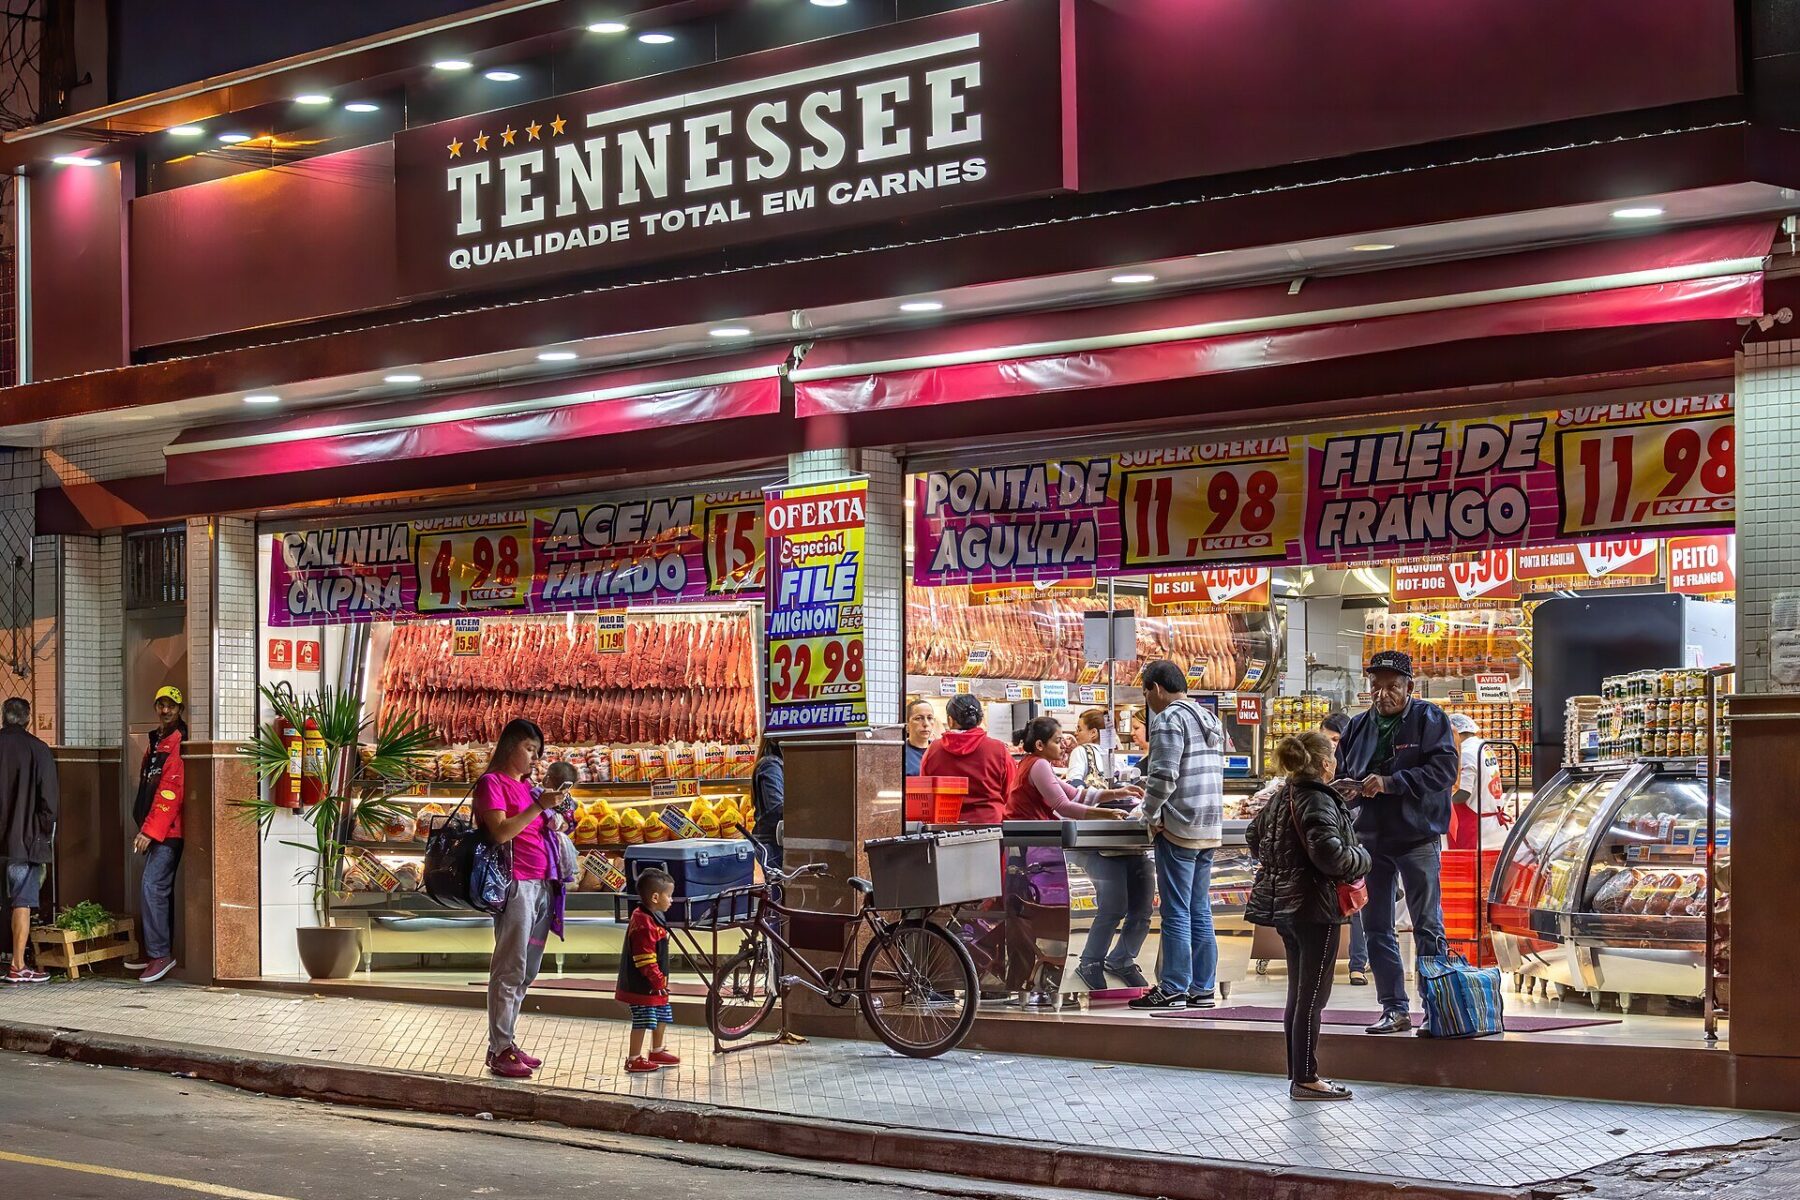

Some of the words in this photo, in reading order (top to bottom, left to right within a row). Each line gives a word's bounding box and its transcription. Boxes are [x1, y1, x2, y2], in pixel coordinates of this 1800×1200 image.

[447, 61, 982, 236] TENNESSEE
[449, 218, 631, 270] QUALIDADE
[640, 197, 751, 236] TOTAL
[762, 184, 816, 216] EM
[828, 156, 988, 207] CARNES
[1557, 401, 1645, 426] SUPER
[1119, 444, 1192, 468] SUPER
[1200, 436, 1290, 458] OFERTA
[1320, 422, 1444, 487] FILÉ
[1459, 418, 1542, 475] DE
[925, 464, 1048, 515] PONTA
[1057, 459, 1110, 507] DE
[1580, 425, 1735, 526] 11,98
[768, 497, 865, 531] OFERTA
[1135, 470, 1279, 558] 11,98
[1317, 484, 1531, 549] FRANGO
[1656, 497, 1735, 515] KILO
[543, 499, 695, 550] ACEM
[282, 523, 411, 569] GALINHA
[780, 532, 844, 564] Especial
[929, 520, 1097, 573] AGULHA
[1203, 533, 1270, 551] KILO
[1672, 545, 1719, 571] PEITO
[431, 535, 519, 605] 4,98
[1519, 553, 1541, 568] PONTA
[1541, 553, 1549, 567] DE
[1549, 552, 1575, 567] AGULHA
[541, 554, 687, 600] FATIADO
[779, 553, 857, 606] FILÉ
[1154, 582, 1170, 595] DE
[1172, 580, 1196, 593] SOL
[1396, 577, 1446, 591] HOT-DOG
[1673, 576, 1686, 587] DE
[1687, 571, 1724, 585] FRANGO
[287, 573, 403, 616] CAIPIRA
[472, 588, 514, 600] KILO
[770, 606, 838, 634] MIGNON
[841, 616, 863, 628] PEÇ
[456, 635, 479, 650] 15,98
[600, 632, 624, 648] 17,98
[771, 639, 864, 701] 32,98
[822, 684, 861, 694] KILO
[1241, 700, 1256, 709] FILA
[769, 705, 866, 726] APROVEITE...
[1238, 708, 1259, 719] ÚNICA
